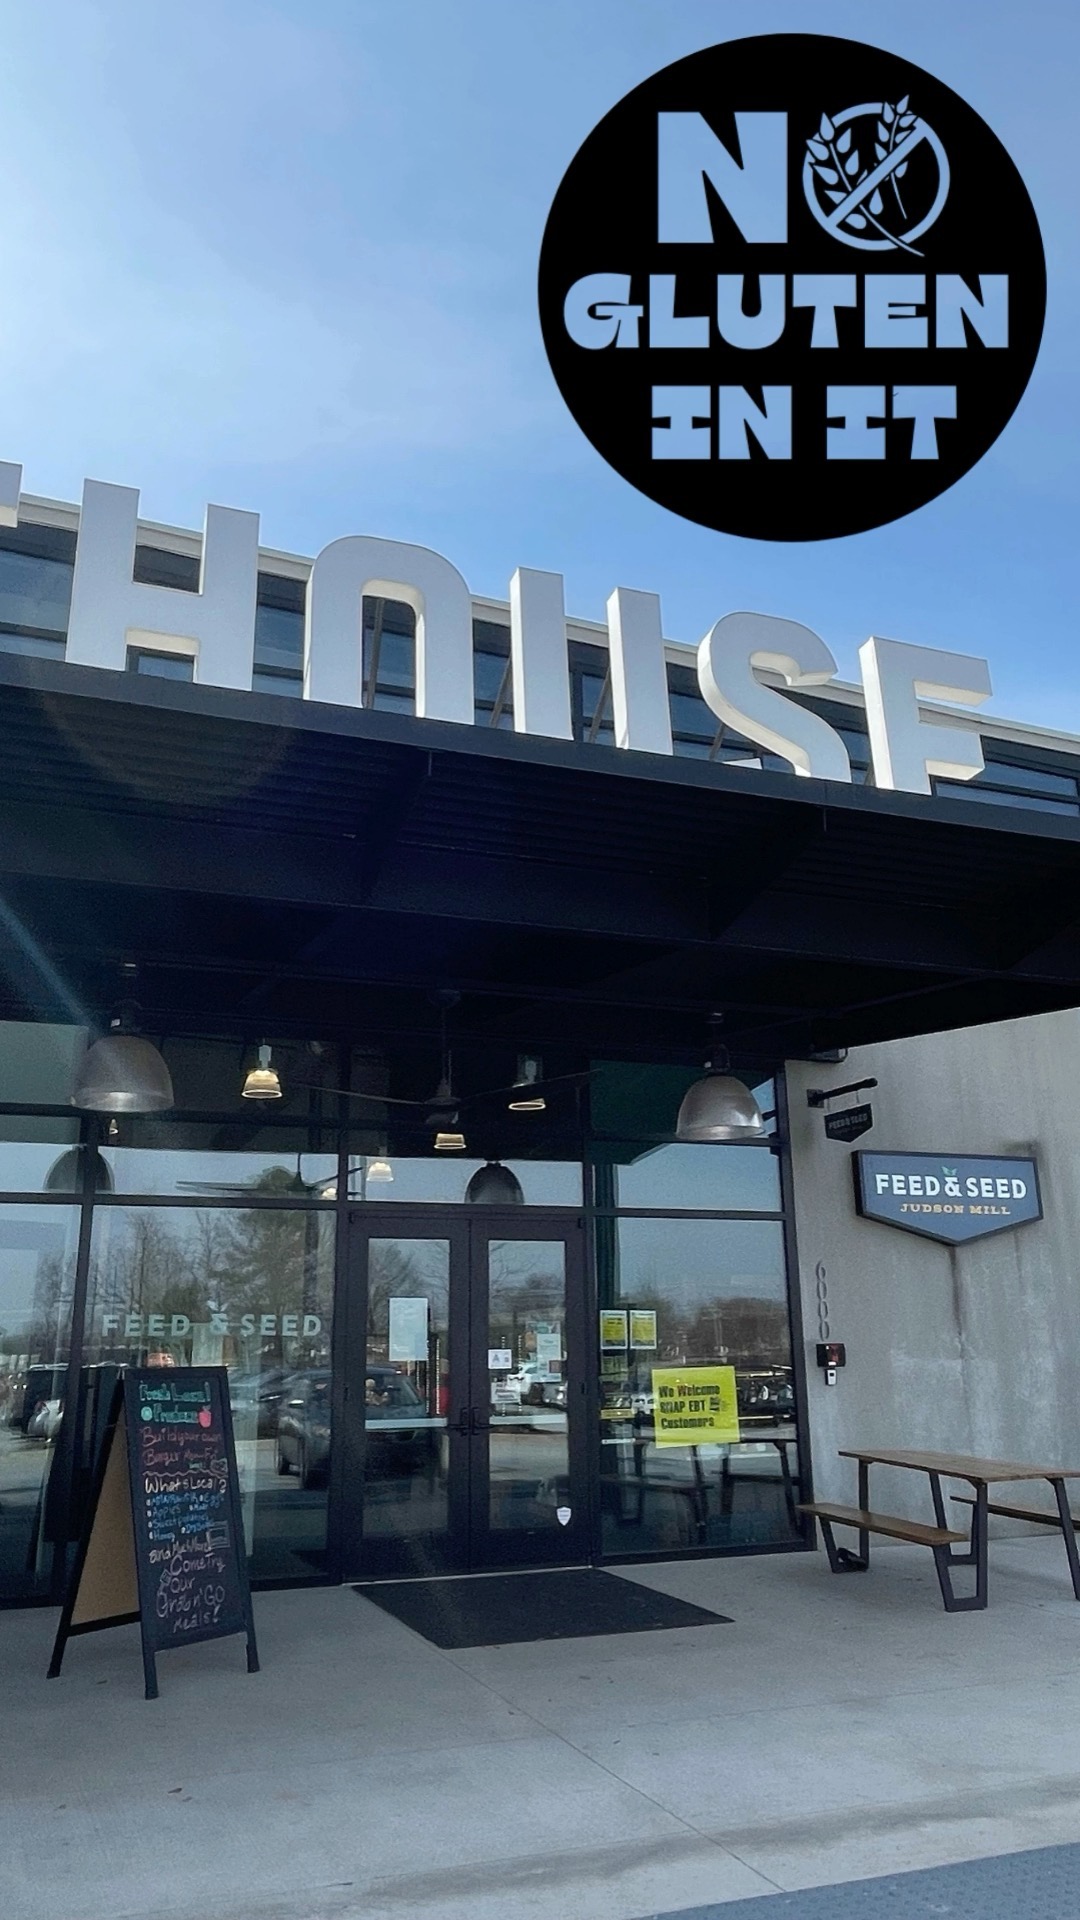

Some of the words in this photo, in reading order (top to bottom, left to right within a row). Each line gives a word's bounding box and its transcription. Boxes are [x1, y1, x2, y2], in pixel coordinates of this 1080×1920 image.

[875, 1173, 941, 1196] FEED
[944, 1176, 963, 1197] &
[964, 1176, 1027, 1199] SEED
[900, 1203, 965, 1214] JUDSON
[968, 1204, 1011, 1215] MILL
[101, 1313, 191, 1337] FEED
[209, 1312, 230, 1336] &
[240, 1312, 322, 1337] SEED
[658, 1385, 674, 1398] We
[677, 1384, 720, 1397] Welcome
[688, 1399, 706, 1413] EBT
[661, 1416, 715, 1430] Customers
